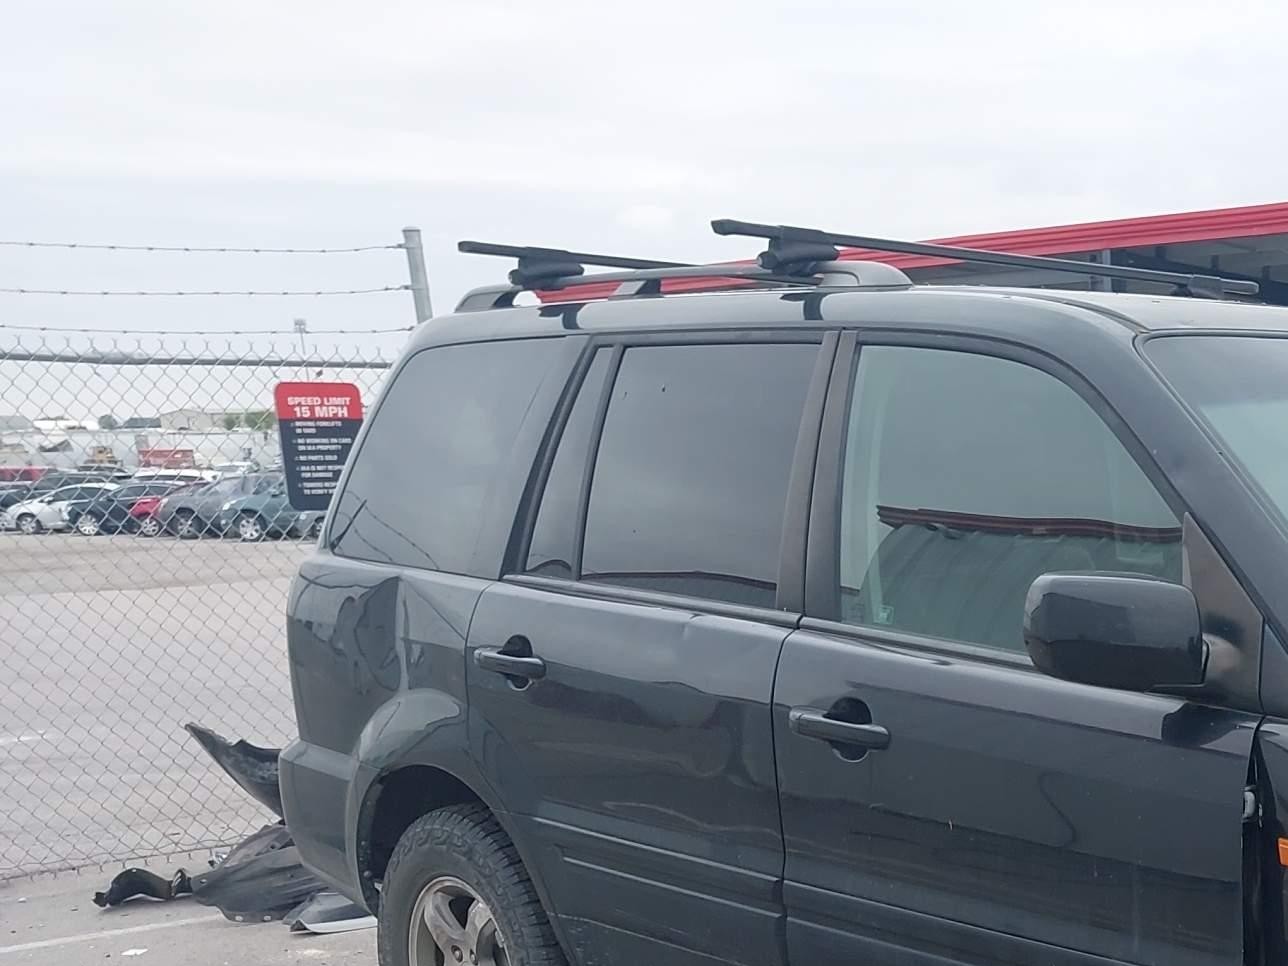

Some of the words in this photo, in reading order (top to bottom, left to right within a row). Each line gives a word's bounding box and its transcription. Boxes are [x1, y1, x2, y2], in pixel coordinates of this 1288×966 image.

[287, 396, 321, 406] SPEED
[323, 397, 352, 406] LIMIT
[294, 406, 311, 418] 15
[314, 406, 349, 418] MPH
